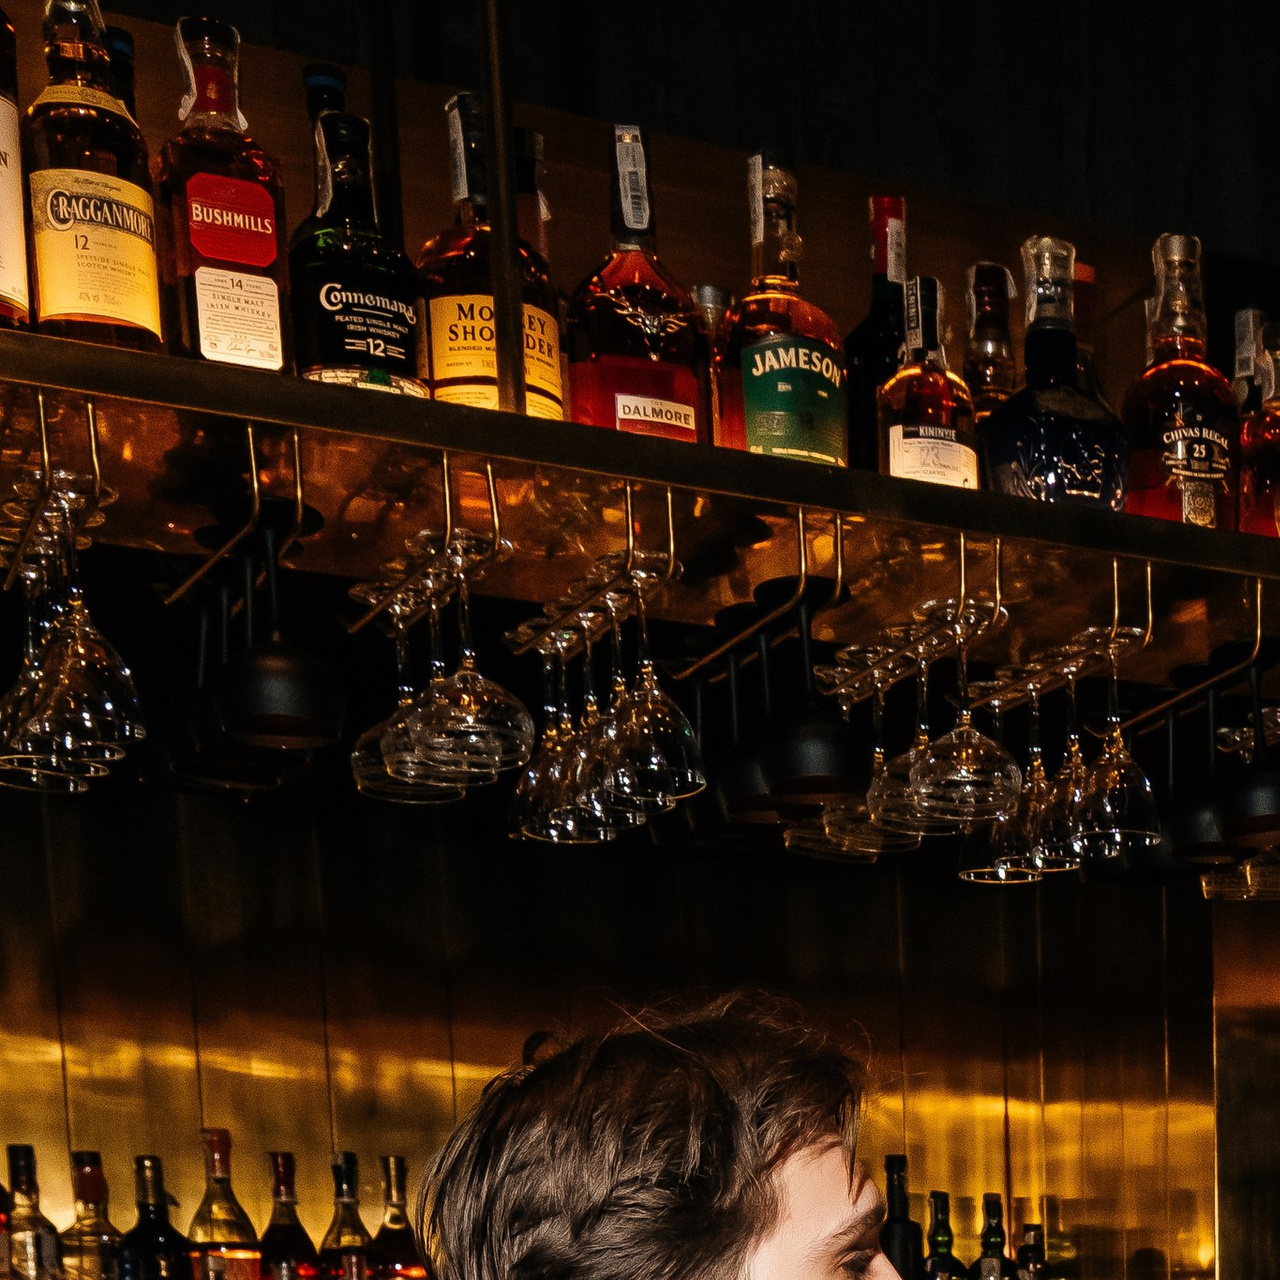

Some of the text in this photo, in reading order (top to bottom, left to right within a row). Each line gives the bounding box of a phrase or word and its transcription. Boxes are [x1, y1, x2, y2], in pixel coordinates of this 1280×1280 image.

[192, 203, 273, 234] BUSHMILLS
[75, 234, 91, 250] 12
[230, 278, 243, 291] 14
[211, 293, 265, 308] SINGLE MALT
[234, 305, 272, 319] WHISKEY
[335, 315, 364, 323] PEATED
[366, 318, 391, 329] SINGLE
[347, 324, 367, 332] IRISH
[367, 338, 385, 357] 12
[751, 347, 842, 389] JAMESON
[622, 404, 691, 426] DALMORE
[919, 425, 956, 442] KININVIE
[1163, 427, 1229, 450] CHIVAS REGAL
[1192, 444, 1206, 458] 25
